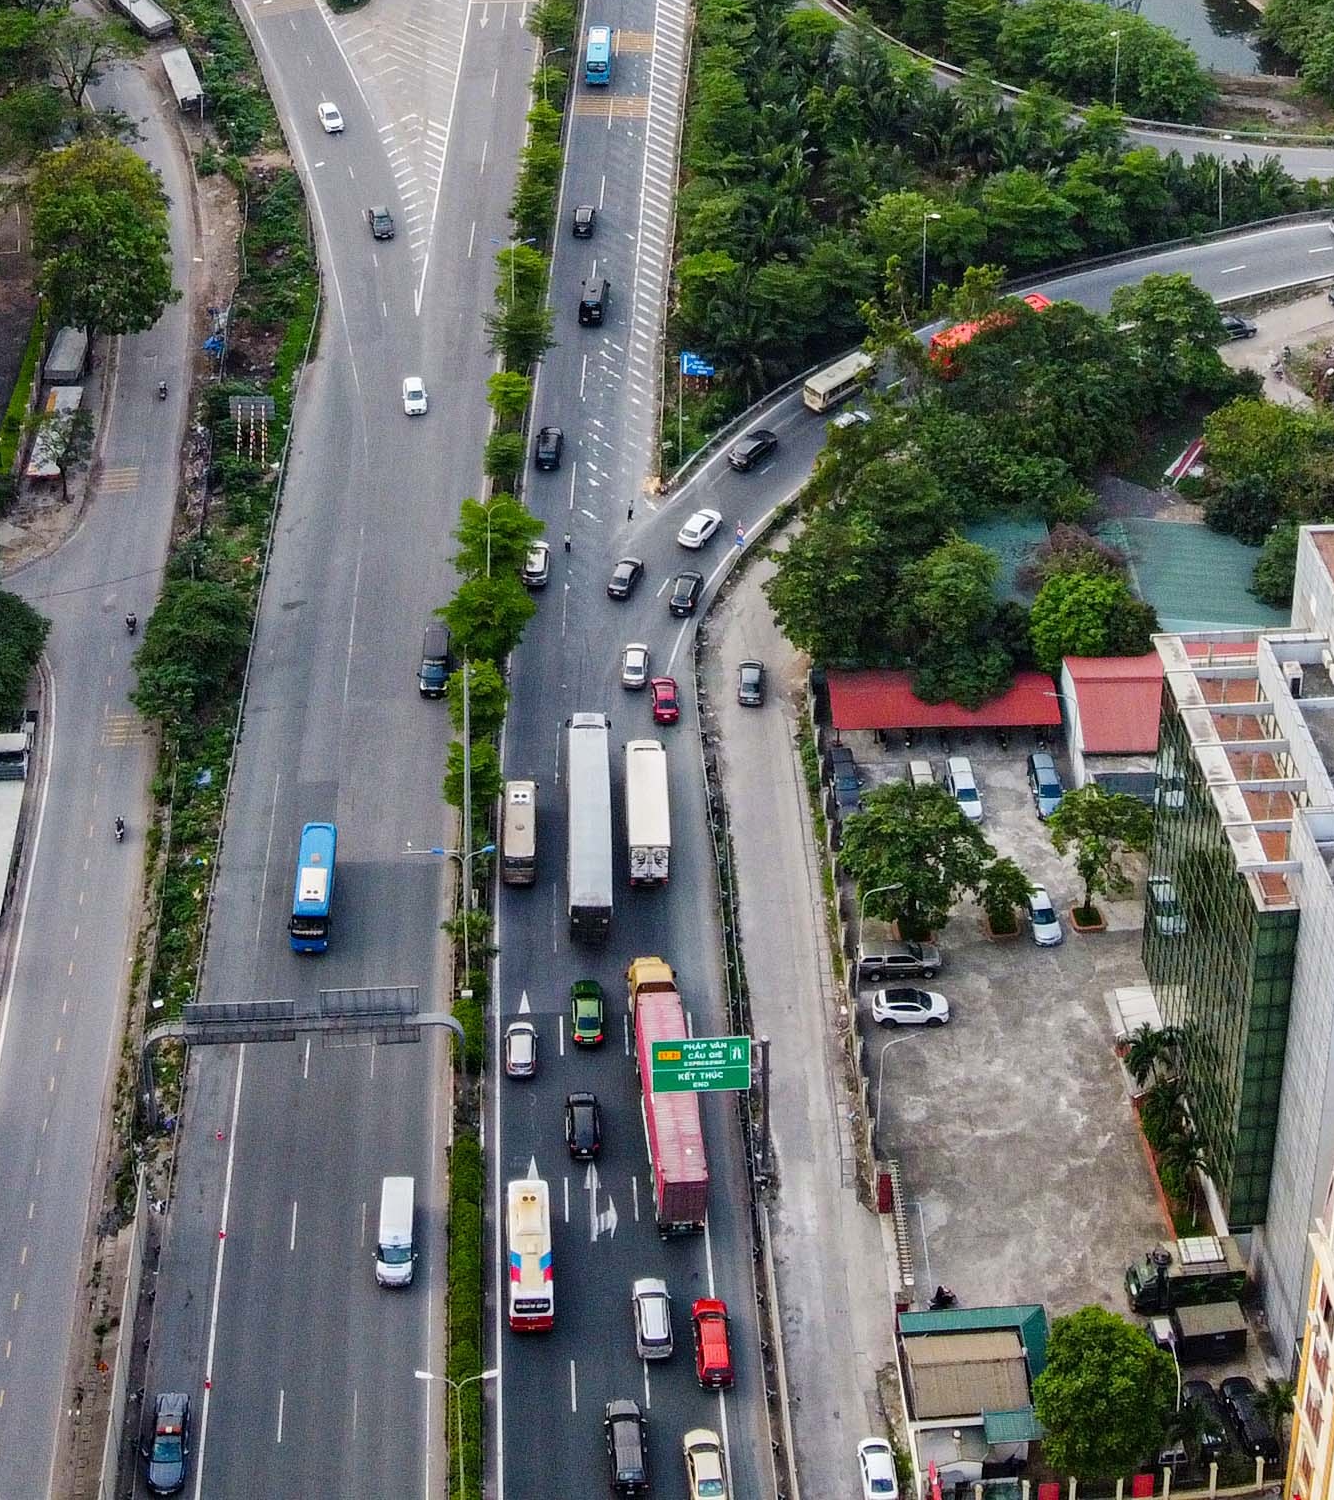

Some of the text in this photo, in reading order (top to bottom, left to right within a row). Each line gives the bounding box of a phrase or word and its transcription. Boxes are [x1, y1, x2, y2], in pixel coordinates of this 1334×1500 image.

[683, 1041, 728, 1050] PHÁP VÂN
[678, 1070, 724, 1081] KẾT THÚC
